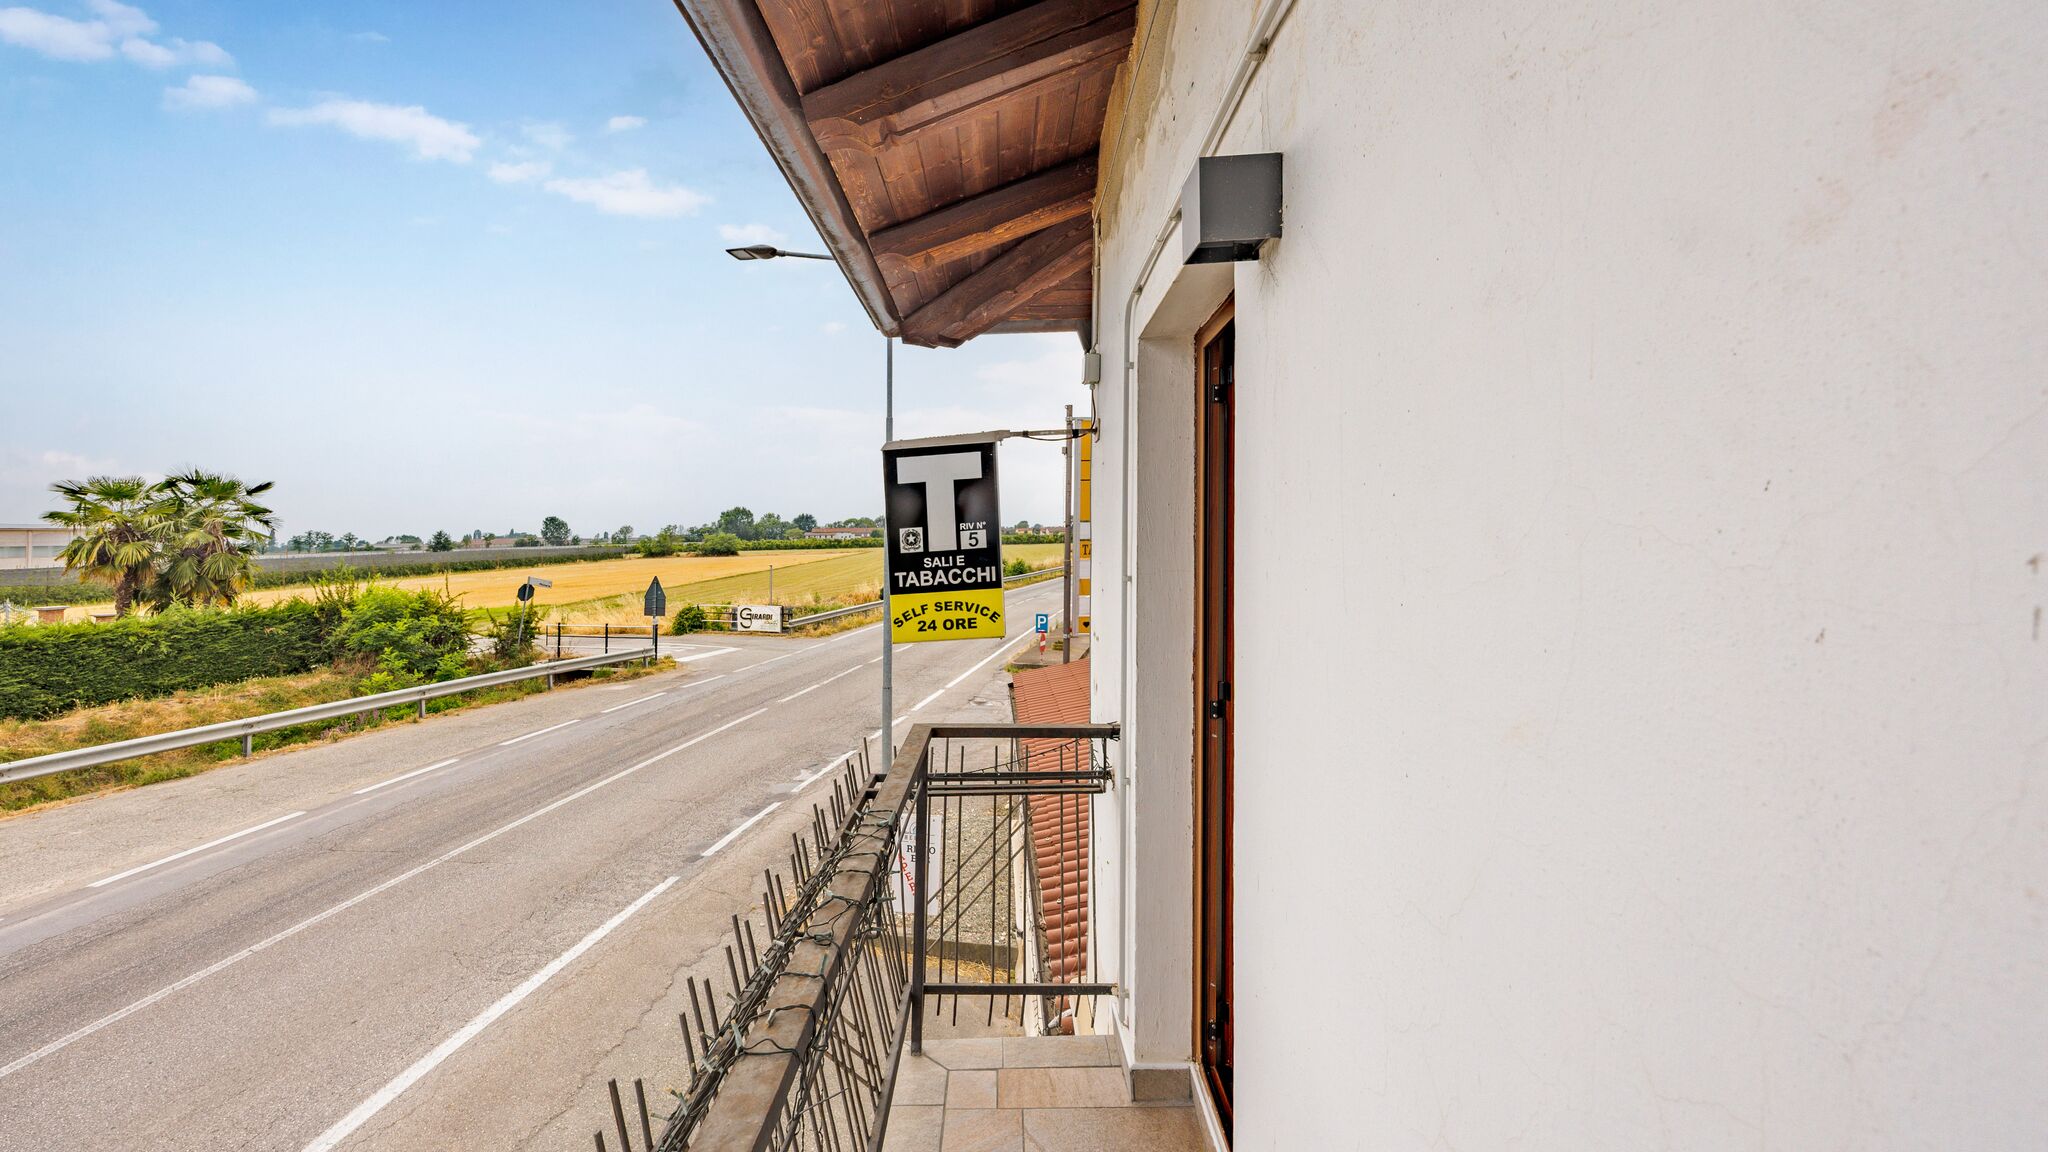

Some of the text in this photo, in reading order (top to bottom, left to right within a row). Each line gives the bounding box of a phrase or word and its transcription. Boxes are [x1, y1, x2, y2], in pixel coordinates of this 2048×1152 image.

[896, 451, 982, 552] T
[968, 532, 979, 547] 5
[1082, 544, 1091, 556] T
[923, 555, 965, 568] SALI E
[894, 566, 996, 588] TABACCHI
[893, 601, 1001, 628] SELF SERVICE
[1037, 615, 1047, 628] P
[917, 617, 978, 632] 24 ORE
